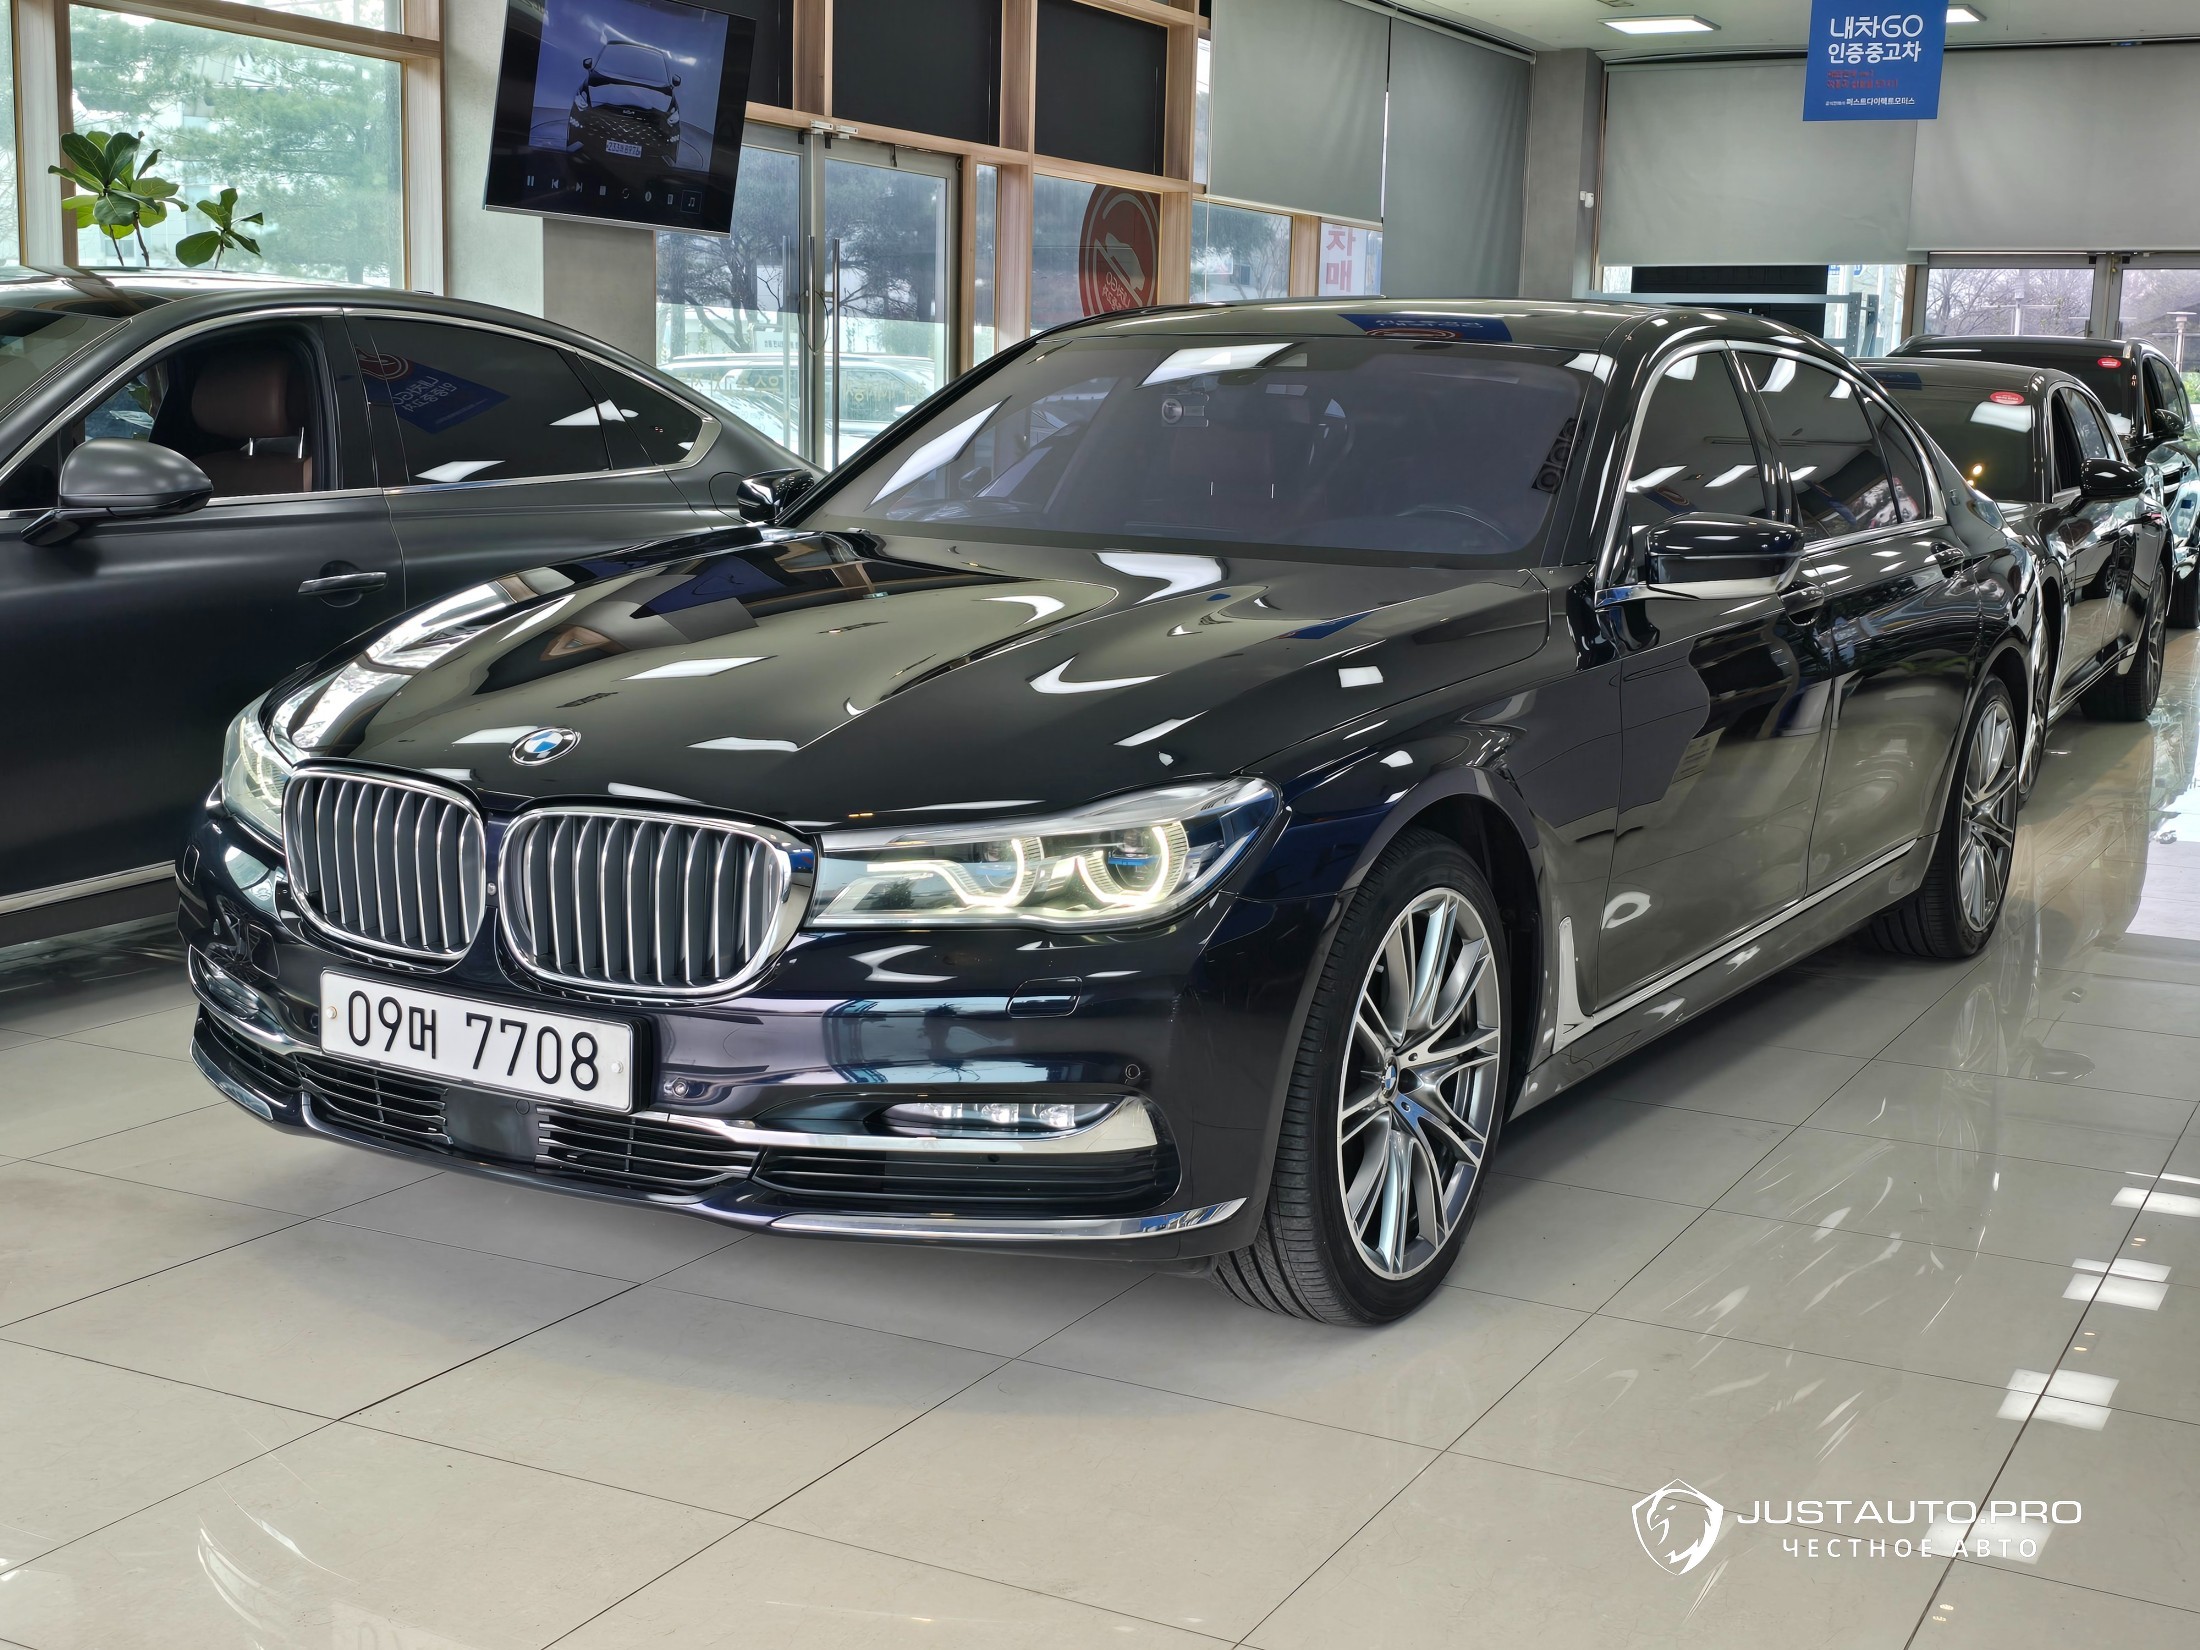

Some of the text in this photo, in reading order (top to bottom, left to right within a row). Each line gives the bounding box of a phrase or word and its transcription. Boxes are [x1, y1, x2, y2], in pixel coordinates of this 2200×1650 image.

[1830, 14, 1924, 39] 내차GO
[1828, 41, 1922, 64] 인증중고차
[348, 990, 599, 1091] 09머 7708
